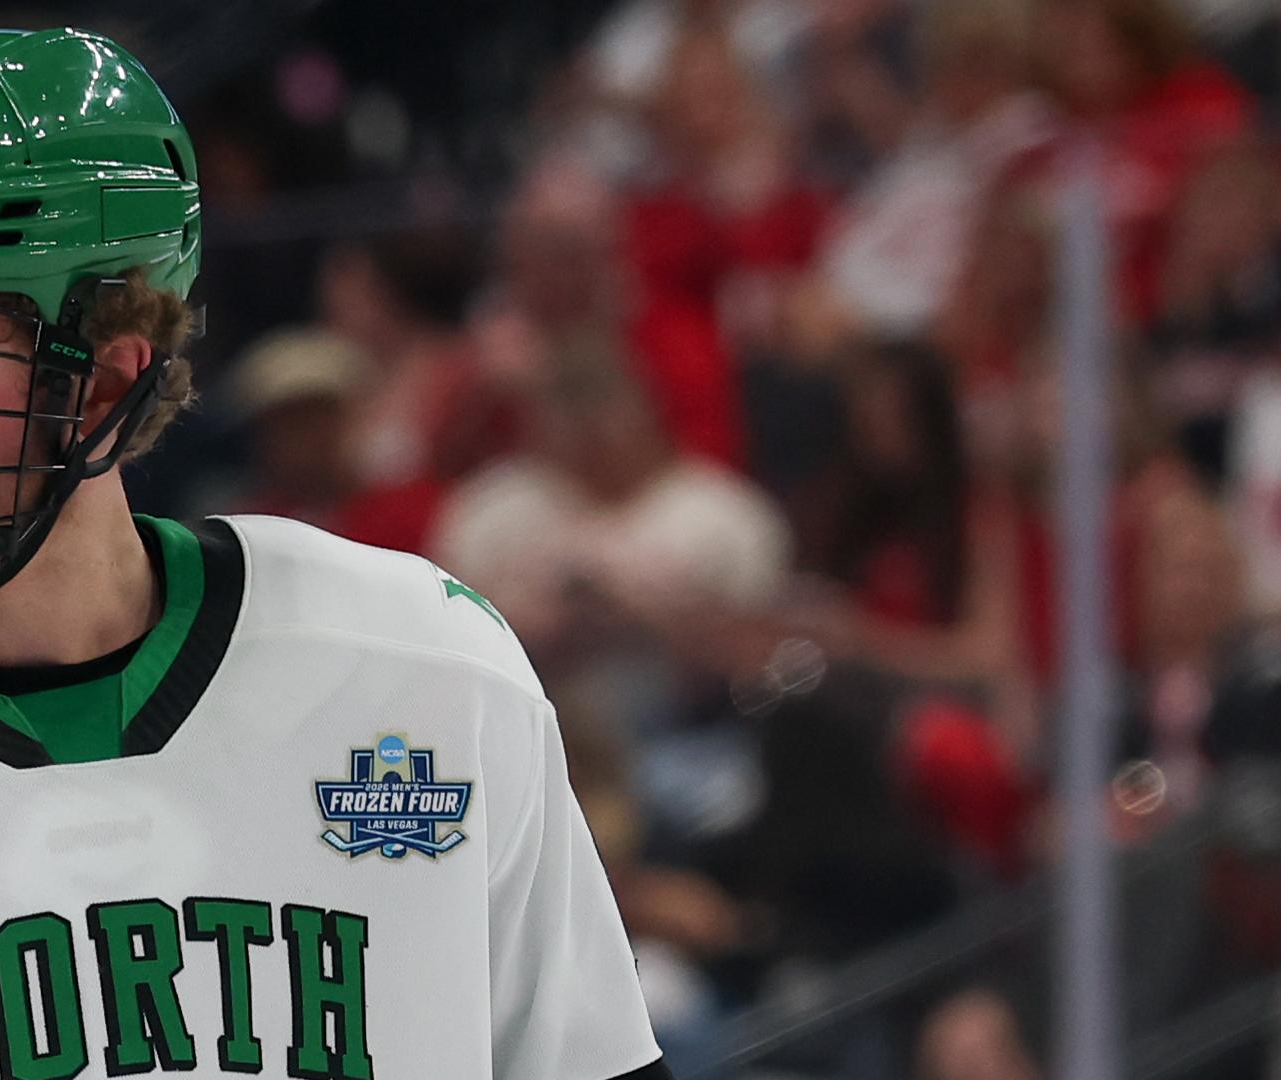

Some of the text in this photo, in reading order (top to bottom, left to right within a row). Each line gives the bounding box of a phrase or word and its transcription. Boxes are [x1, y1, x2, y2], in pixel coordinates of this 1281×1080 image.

[50, 342, 88, 360] CCM
[329, 791, 458, 813] FROZEN FOUR
[366, 820, 419, 830] LAS VEGAS
